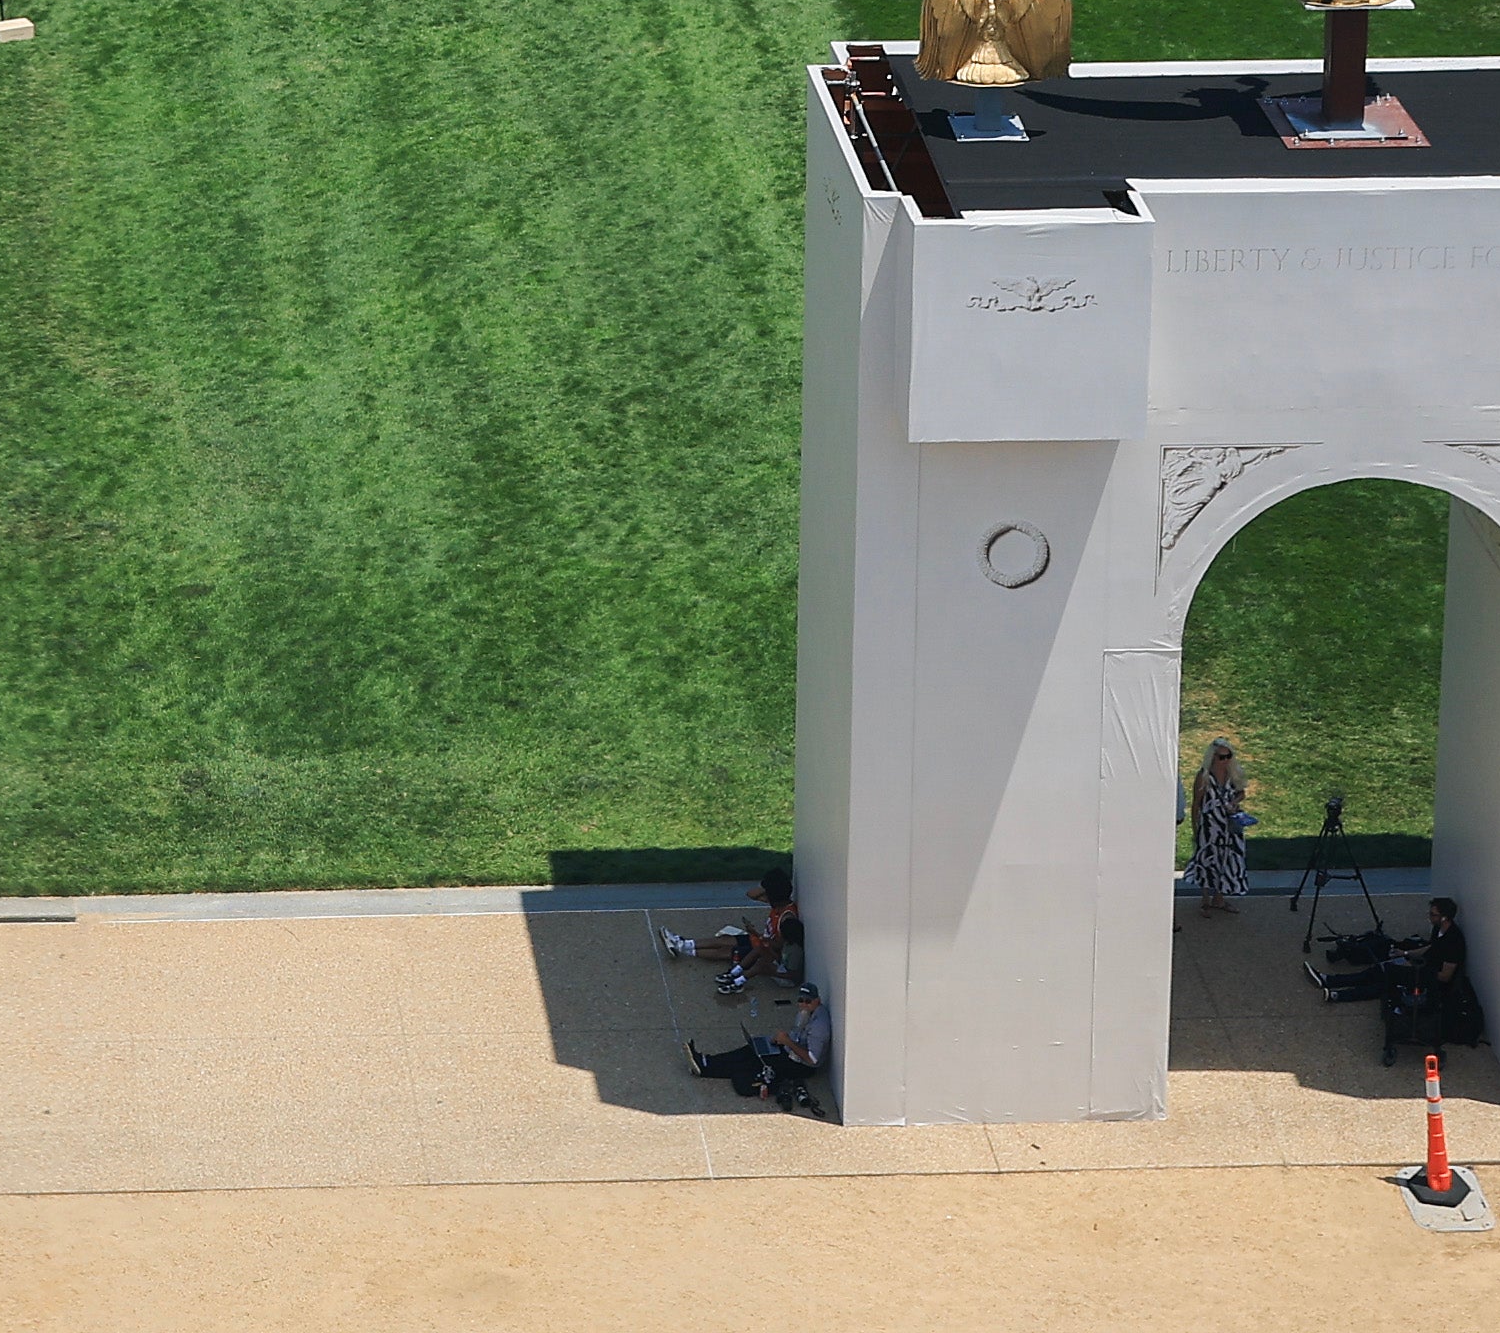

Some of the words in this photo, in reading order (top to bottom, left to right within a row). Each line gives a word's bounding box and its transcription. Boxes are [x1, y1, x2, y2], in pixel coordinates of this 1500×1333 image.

[1166, 247, 1291, 273] LIBERTY
[1300, 246, 1322, 271] &
[1335, 245, 1456, 271] JUSTICE
